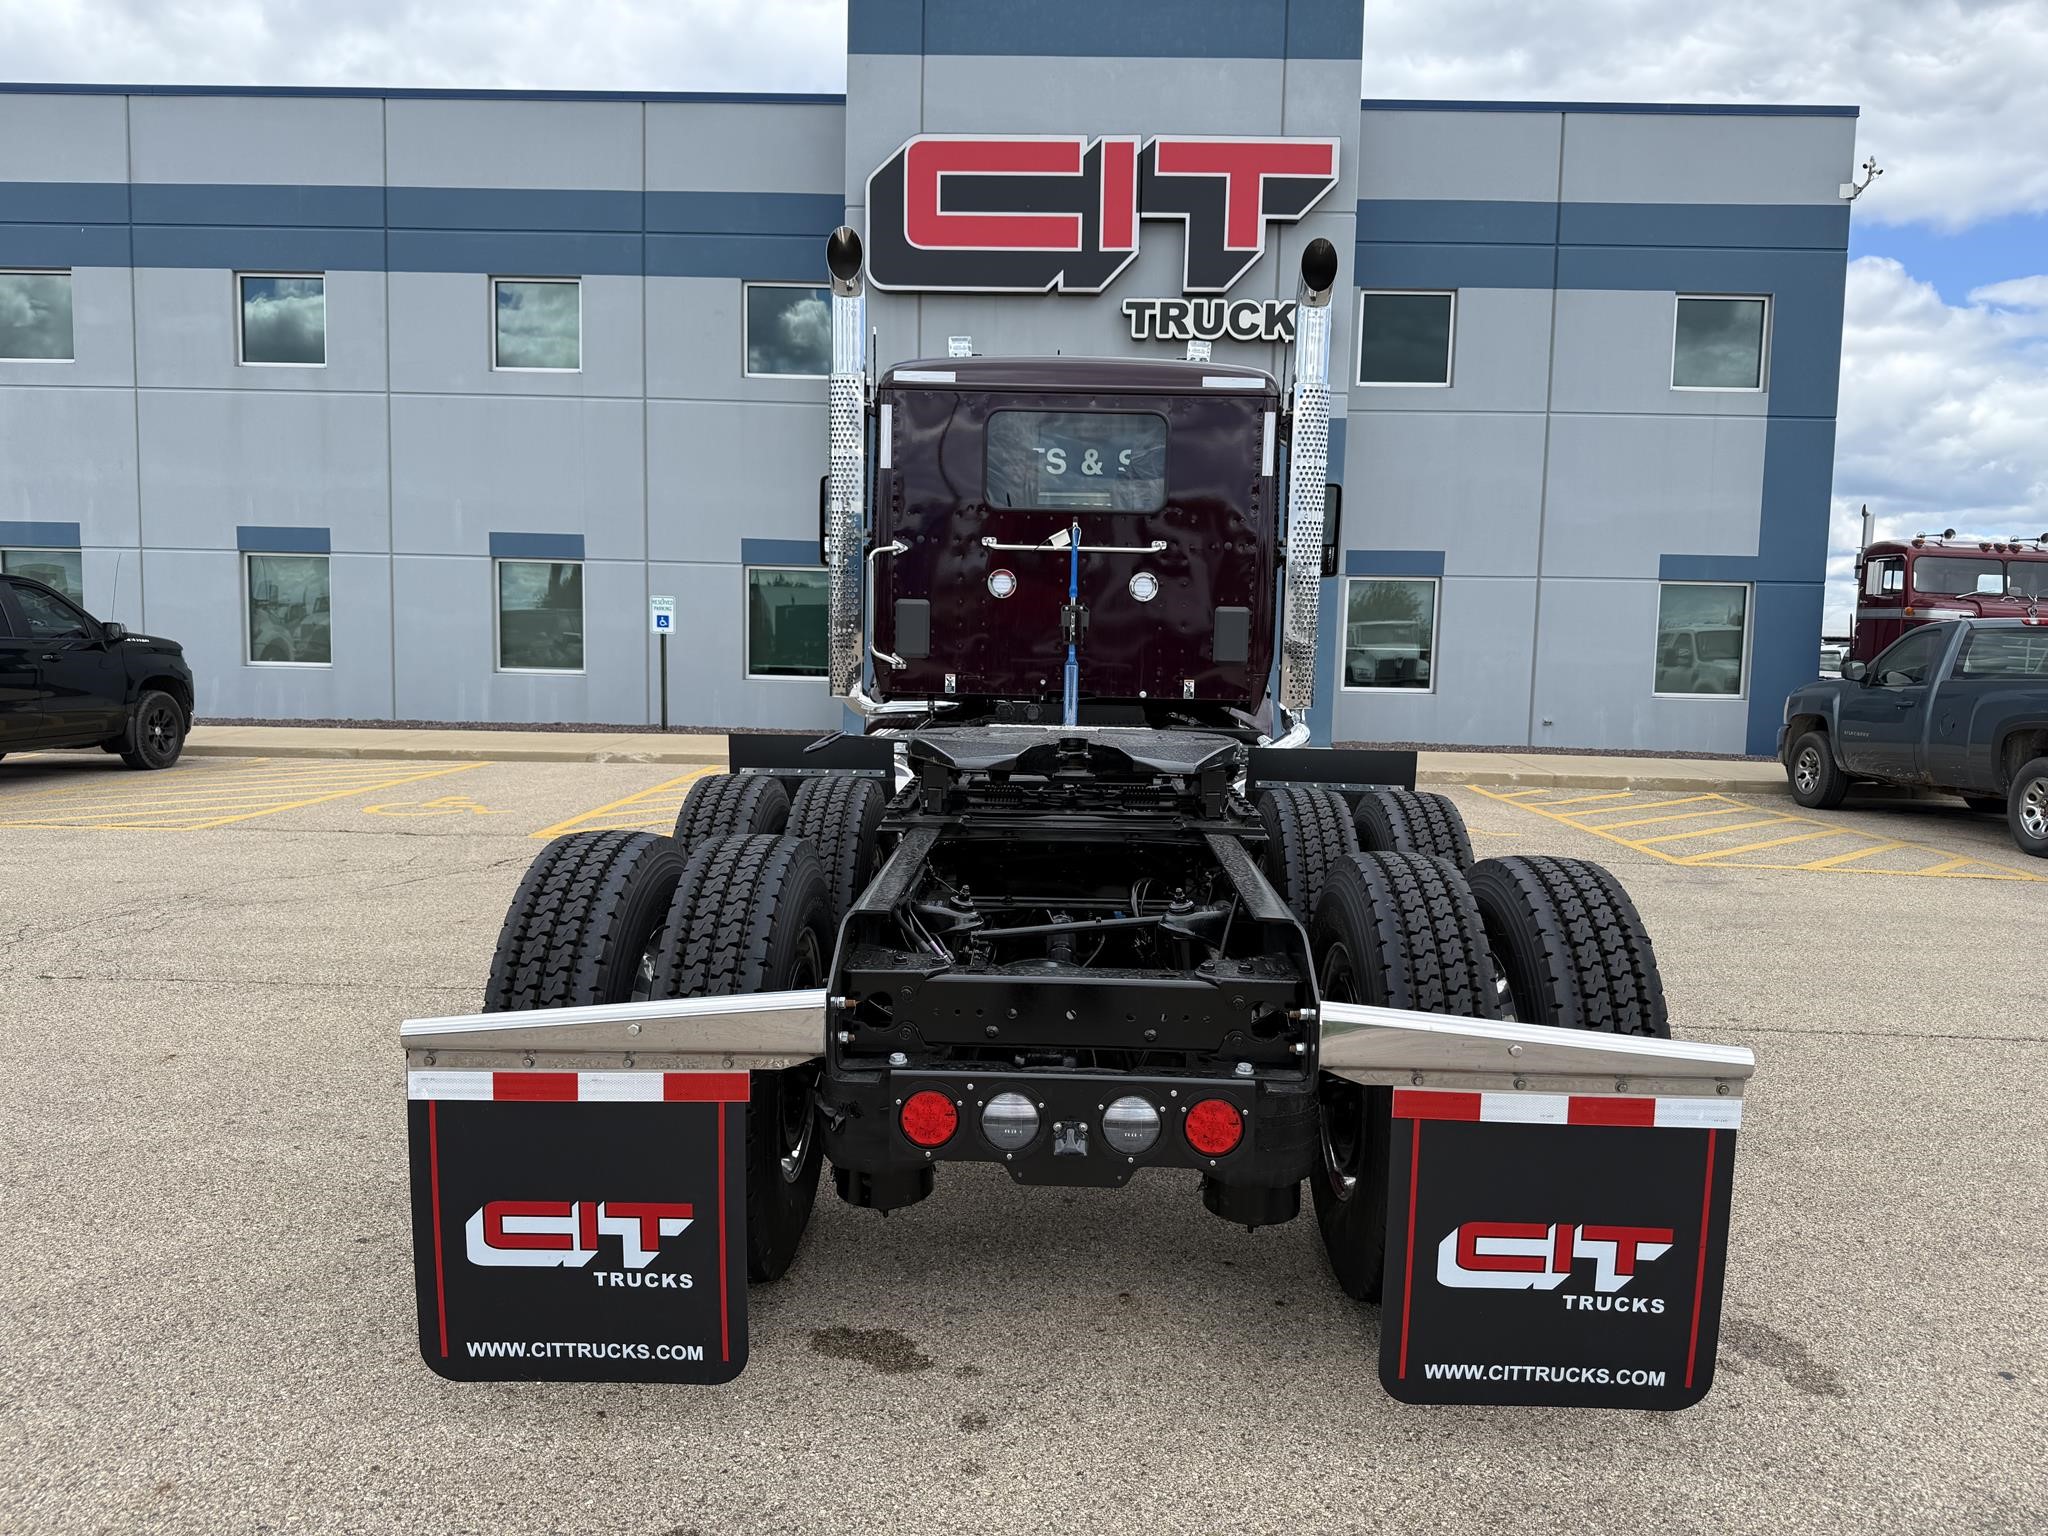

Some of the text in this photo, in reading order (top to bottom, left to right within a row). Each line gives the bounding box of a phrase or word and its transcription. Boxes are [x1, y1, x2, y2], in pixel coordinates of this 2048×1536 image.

[866, 133, 1341, 294] CIT
[1122, 297, 1297, 341] TRUCK
[1081, 449, 1103, 475] &
[466, 1200, 694, 1269] CIT
[1436, 1221, 1674, 1292] CIT
[593, 1271, 694, 1289] TRUCKS
[1562, 1294, 1666, 1314] TRUCKS
[466, 1341, 704, 1362] WWW.CITTRUCKS.COM
[1424, 1363, 1666, 1387] WWW.CITTRUCKS.COM
